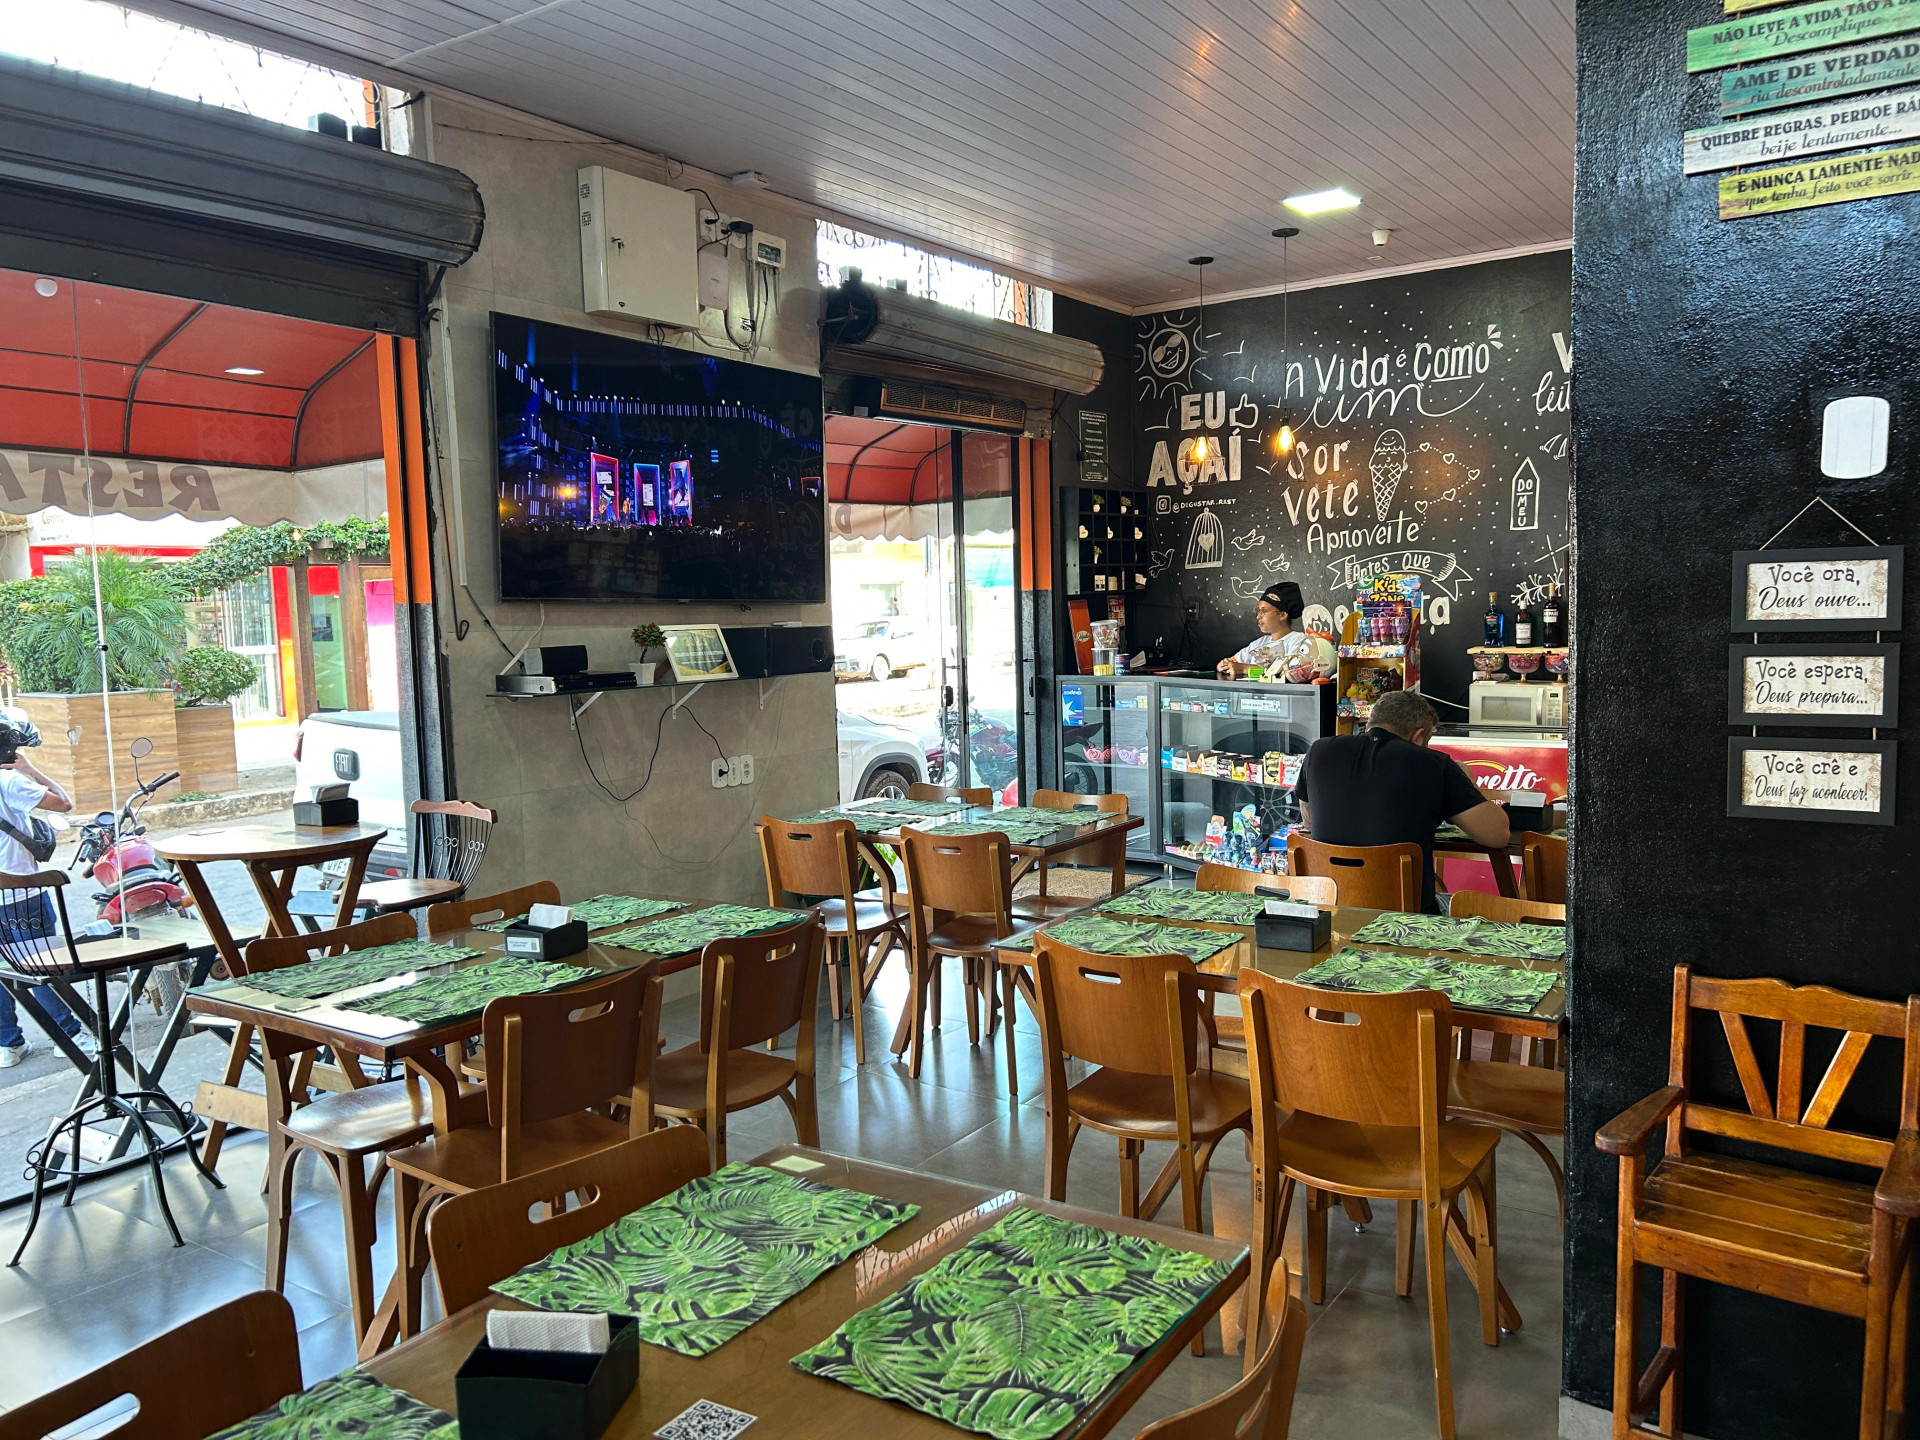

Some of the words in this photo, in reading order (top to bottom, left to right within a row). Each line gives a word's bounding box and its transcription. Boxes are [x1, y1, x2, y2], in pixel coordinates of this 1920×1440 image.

[1713, 27, 1743, 45] NÃO
[1748, 19, 1785, 37] LEVE
[1789, 16, 1800, 29] A
[1804, 9, 1842, 26] VIDA
[1766, 16, 1882, 47] Descomplique
[1731, 70, 1780, 91] AME
[1787, 63, 1816, 80] DE
[1775, 63, 1920, 100] descontroladamente
[1701, 128, 1760, 150] QUEBRE
[1830, 106, 1892, 127] PERDOE
[1896, 96, 1920, 116] RÁ
[1760, 139, 1798, 158] beije
[1737, 180, 1749, 194] E
[1751, 169, 1805, 188] NUNCA
[1809, 156, 1884, 181] LAMENTE
[1744, 194, 1768, 210] que
[1771, 186, 1807, 206] tenha
[1810, 179, 1842, 201] feito
[1844, 175, 1874, 190] você
[1395, 348, 1408, 368] é
[1413, 342, 1490, 381] Como
[1180, 390, 1226, 431] EU
[1146, 427, 1242, 496] AÇAÍ
[1517, 478, 1533, 493] DO
[1517, 495, 1528, 527] MEU
[1307, 510, 1421, 555] Aproveite
[1374, 576, 1404, 593] Kids
[1768, 564, 1815, 586] Você
[1823, 567, 1860, 587] ora,
[1758, 586, 1809, 611] Deus
[1814, 595, 1871, 608] ouve...
[1756, 659, 1798, 681] Você
[1804, 665, 1868, 686] espera,
[1755, 681, 1795, 705] Deus
[1798, 690, 1868, 709] prepara...
[335, 753, 350, 773] FIAT
[1763, 754, 1805, 776] Você
[1812, 758, 1841, 776] crê
[1848, 764, 1859, 776] e
[1754, 774, 1786, 798] Deus
[1788, 780, 1810, 805] faz
[1811, 782, 1868, 801] acontecer!
